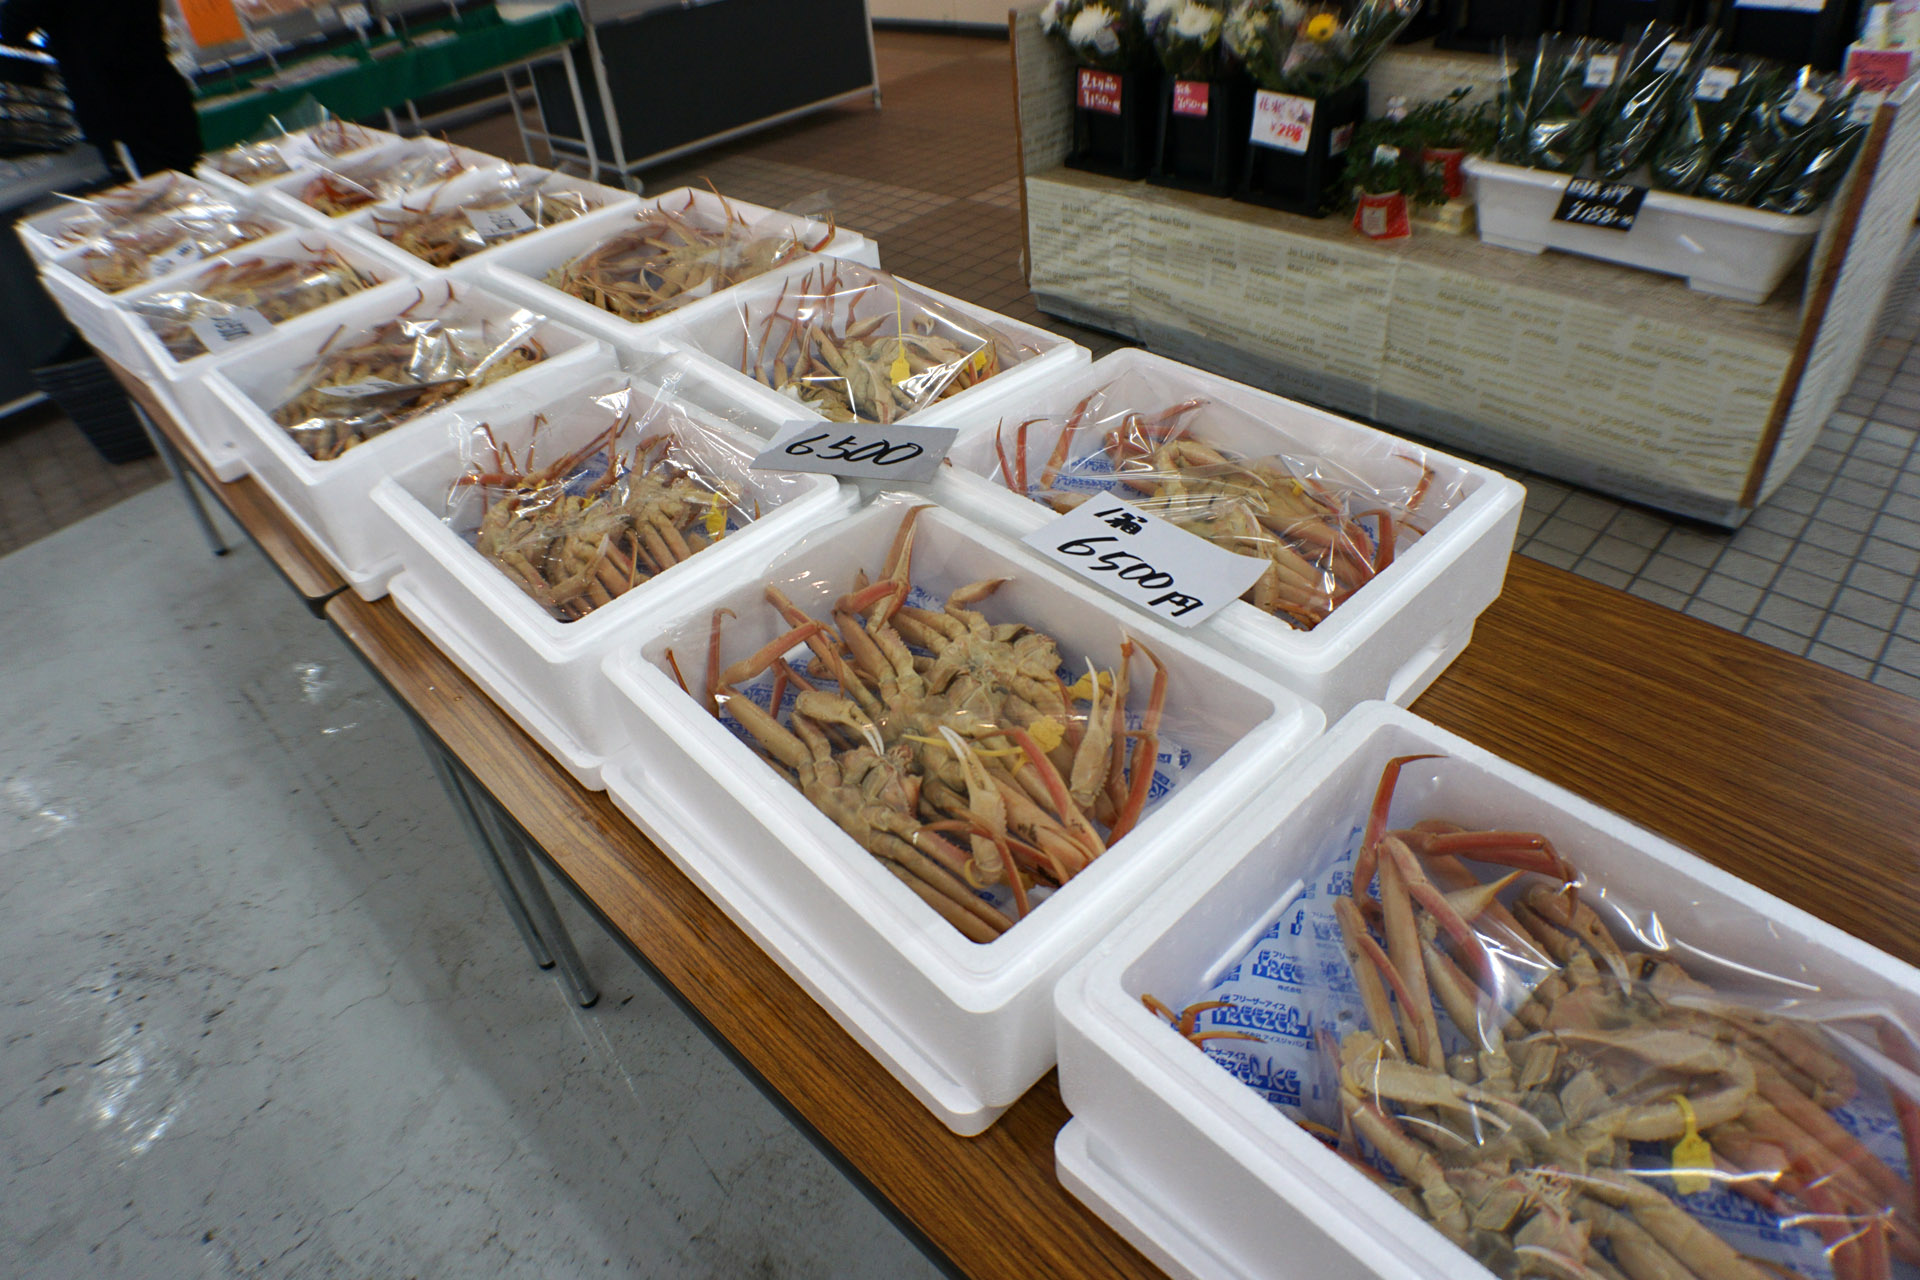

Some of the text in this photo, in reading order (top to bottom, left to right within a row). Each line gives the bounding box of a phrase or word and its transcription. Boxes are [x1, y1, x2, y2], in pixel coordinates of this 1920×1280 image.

[785, 433, 924, 466] 6500
[1056, 536, 1204, 617] 6500円
[1232, 993, 1287, 1011] フリーザーアイス
[1266, 1055, 1298, 1093] ICE
